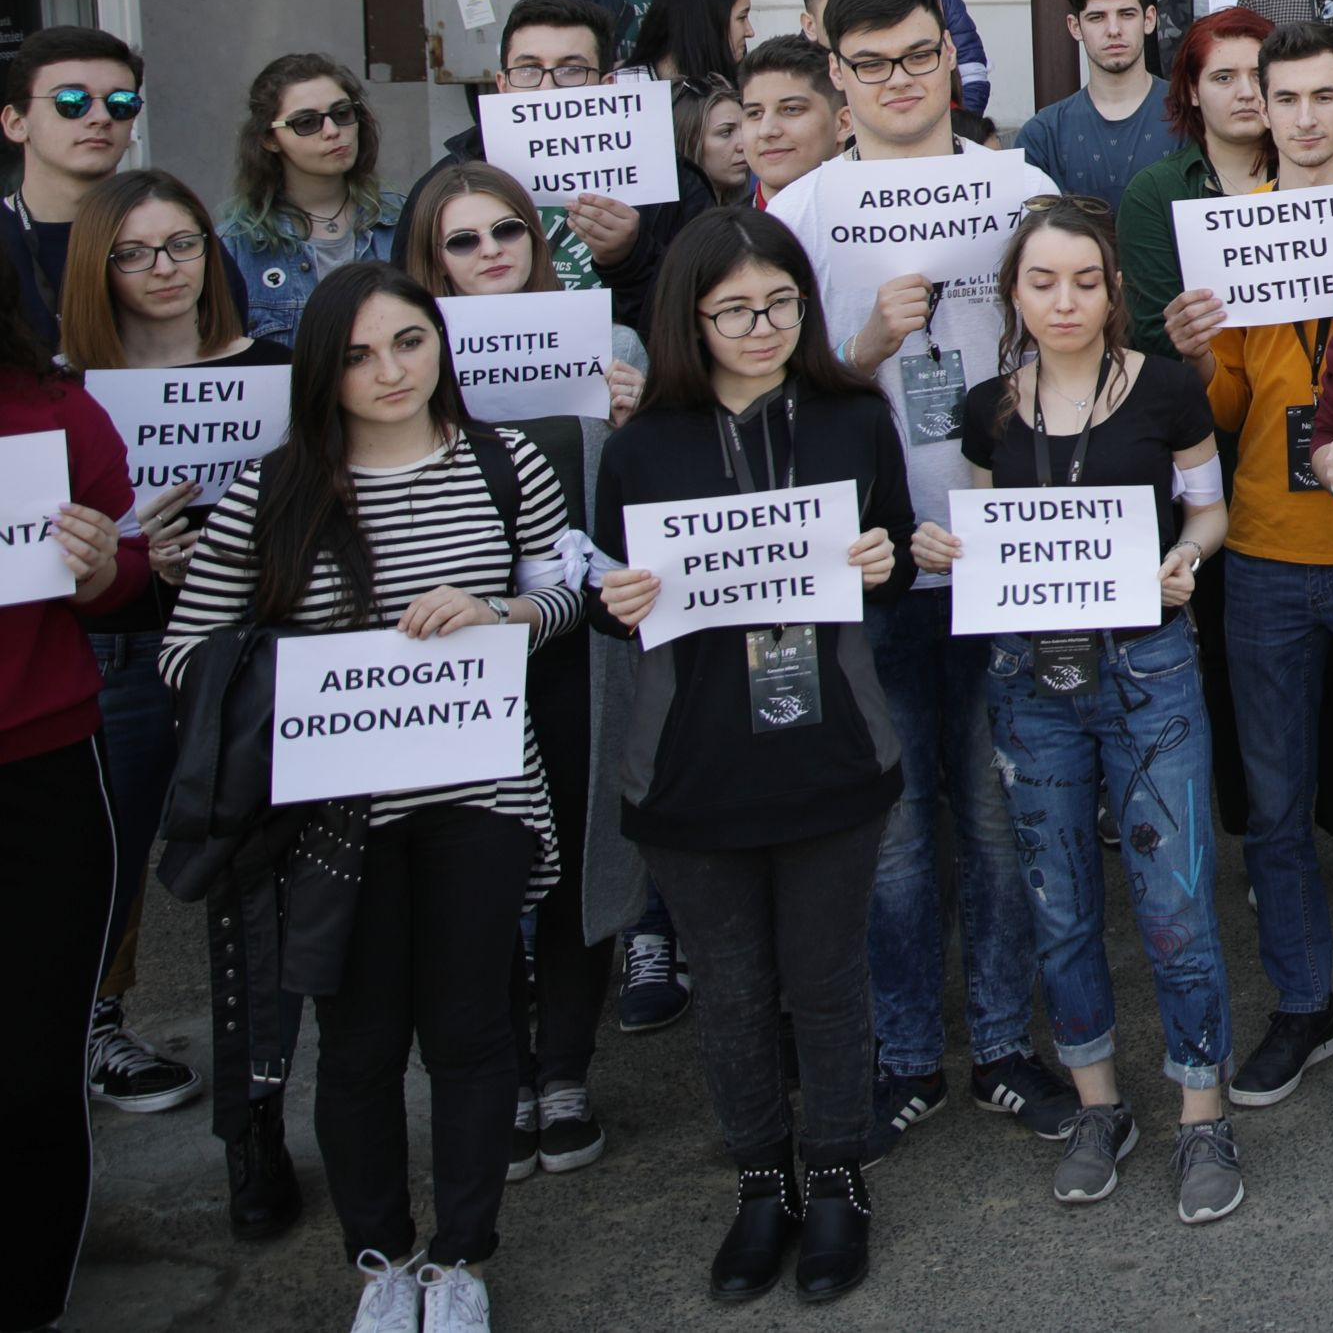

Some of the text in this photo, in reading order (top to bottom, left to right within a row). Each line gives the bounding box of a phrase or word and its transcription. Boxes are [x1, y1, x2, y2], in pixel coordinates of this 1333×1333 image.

[512, 95, 641, 123] STUDENȚI
[529, 131, 631, 158] PENTRU
[532, 166, 637, 192] JUSTIȚIE
[860, 182, 990, 208] ABROGAȚI
[831, 212, 1019, 243] ORDONANȚA 7
[1224, 238, 1327, 267] PENTRU
[456, 332, 558, 354] JUSTIȚIE
[459, 357, 604, 386] EPENDENTĂ
[164, 381, 243, 403] ELEVI
[138, 420, 261, 445] PENTRU
[664, 499, 820, 537] STUDENȚI
[984, 500, 1122, 524] STUDENȚI
[684, 541, 808, 575] PENTRU
[1001, 539, 1111, 563] PENTRU
[684, 576, 814, 610] JUSTIȚIE
[997, 581, 1116, 609] JUSTIȚIE
[320, 659, 483, 692] ABROGAȚI
[281, 697, 518, 739] ORDONANȚA 7
